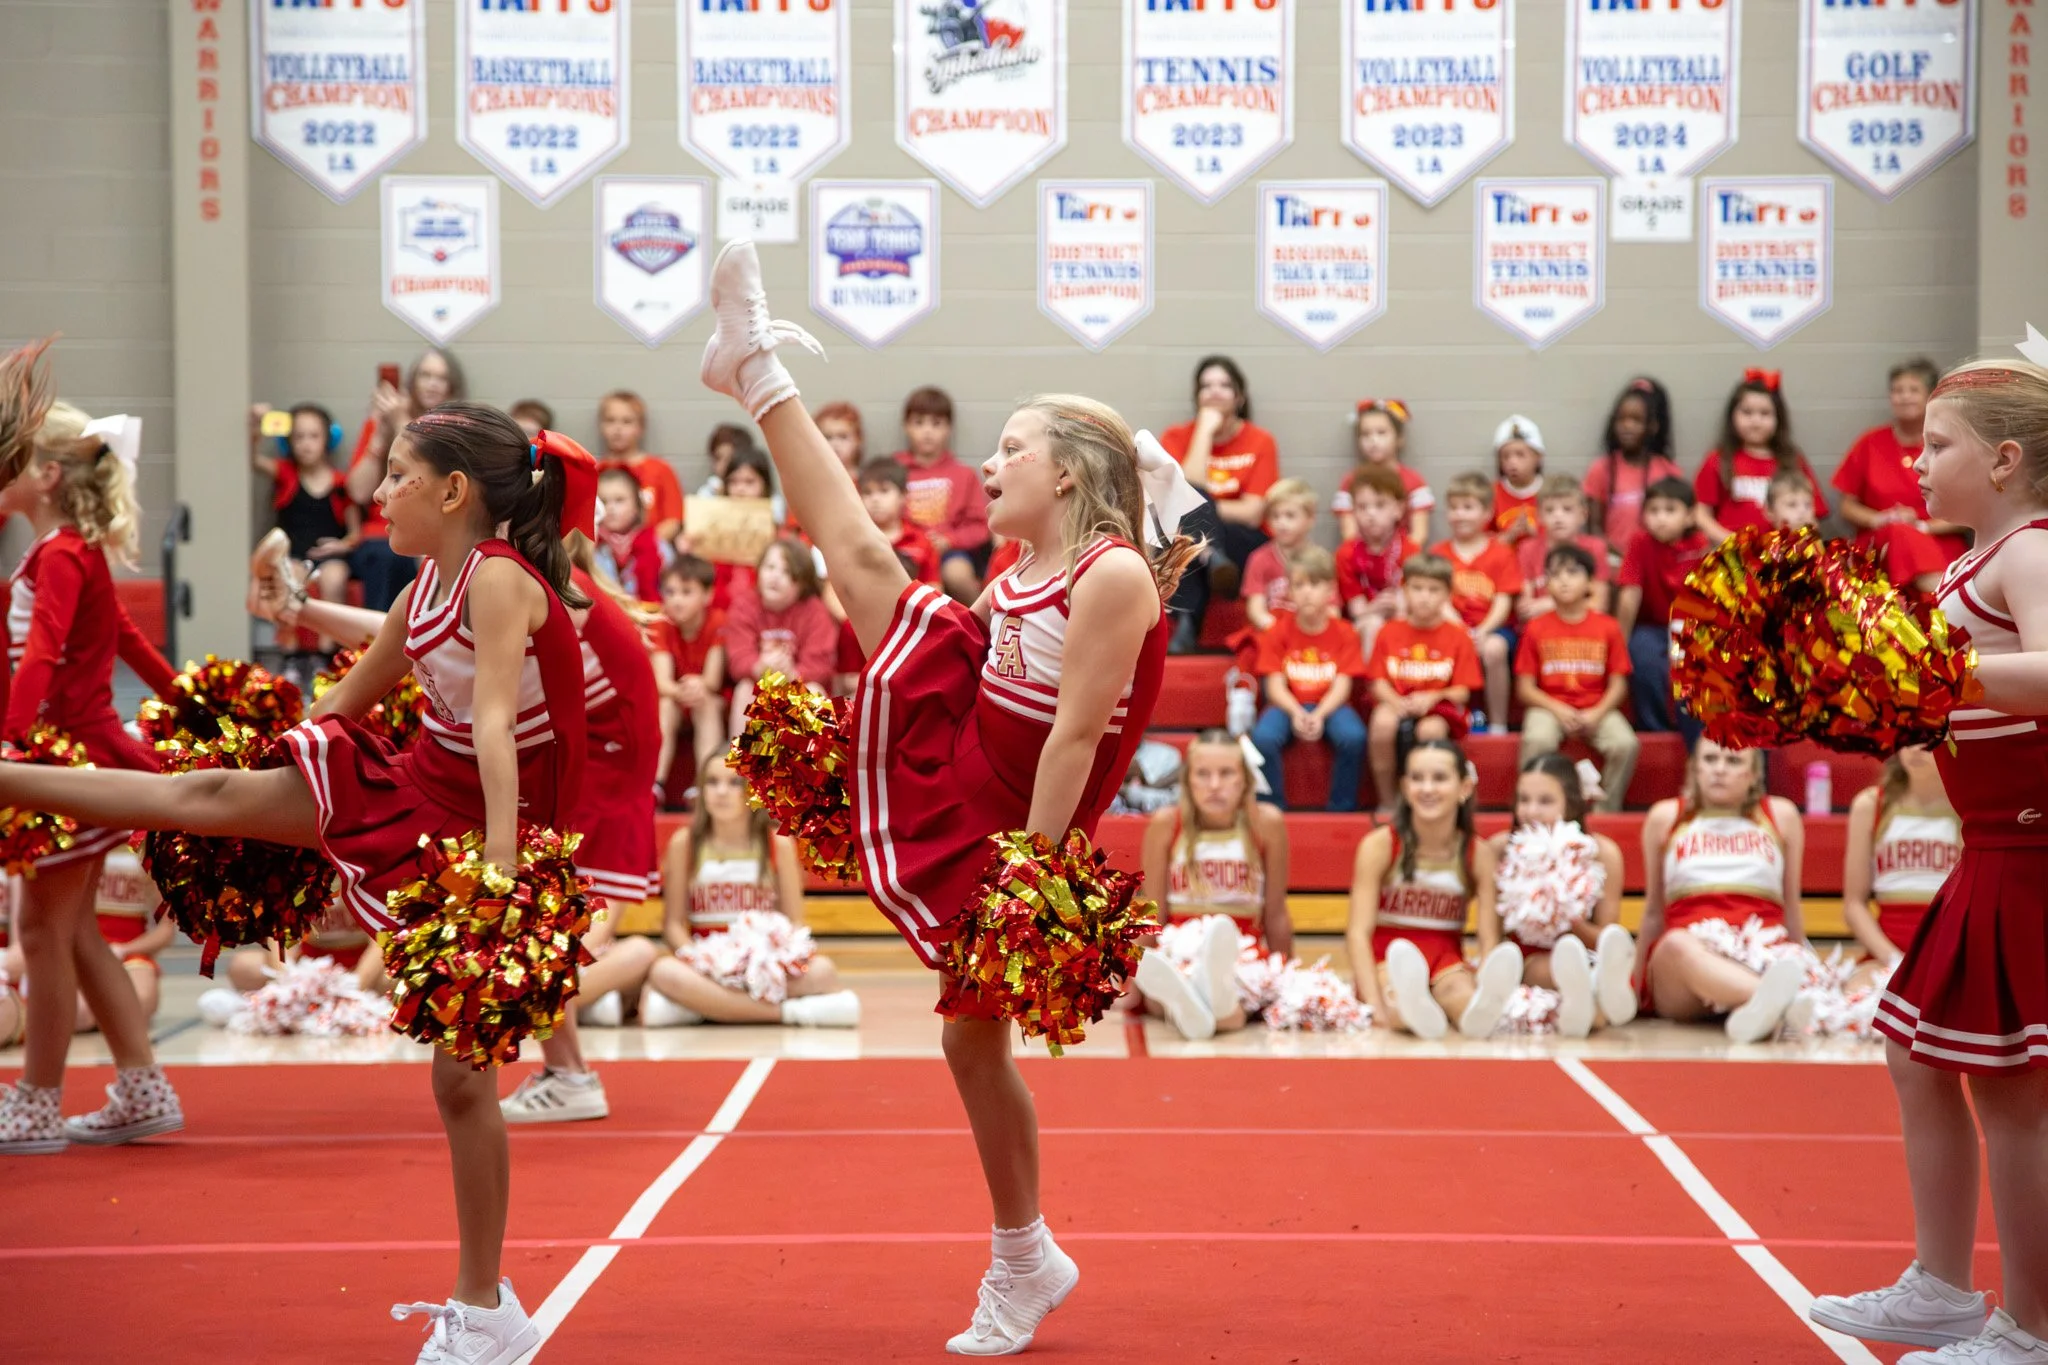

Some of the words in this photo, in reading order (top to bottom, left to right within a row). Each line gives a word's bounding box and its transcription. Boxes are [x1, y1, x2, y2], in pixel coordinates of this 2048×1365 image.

[267, 53, 409, 82] VOLLEYBALL
[472, 56, 612, 85] BASKETBALL
[692, 57, 833, 84] BASKETBALL
[1136, 56, 1279, 83] TENNIS
[1358, 56, 1500, 84] VOLLEYBALL
[1581, 55, 1723, 83] VOLLEYBALL
[1845, 50, 1931, 81] GOLF
[265, 83, 410, 113] CHAMPION
[1136, 84, 1279, 115] CHAMPION
[1356, 84, 1499, 116] CHAMPION
[1579, 84, 1723, 115] CHAMPION
[1812, 81, 1961, 112] CHAMPION
[302, 120, 376, 145] 2022
[506, 124, 579, 149] 2022
[729, 124, 800, 149] 2022
[909, 108, 1054, 137] CHAMPION
[1172, 123, 1244, 148] 2023
[1393, 123, 1464, 148] 2023
[1614, 123, 1688, 148] 2024
[1491, 260, 1589, 278] TENNIS
[1717, 259, 1816, 277] TENNIS
[1676, 829, 1776, 865] WARRIORS
[1876, 838, 1962, 877] WARRIOR
